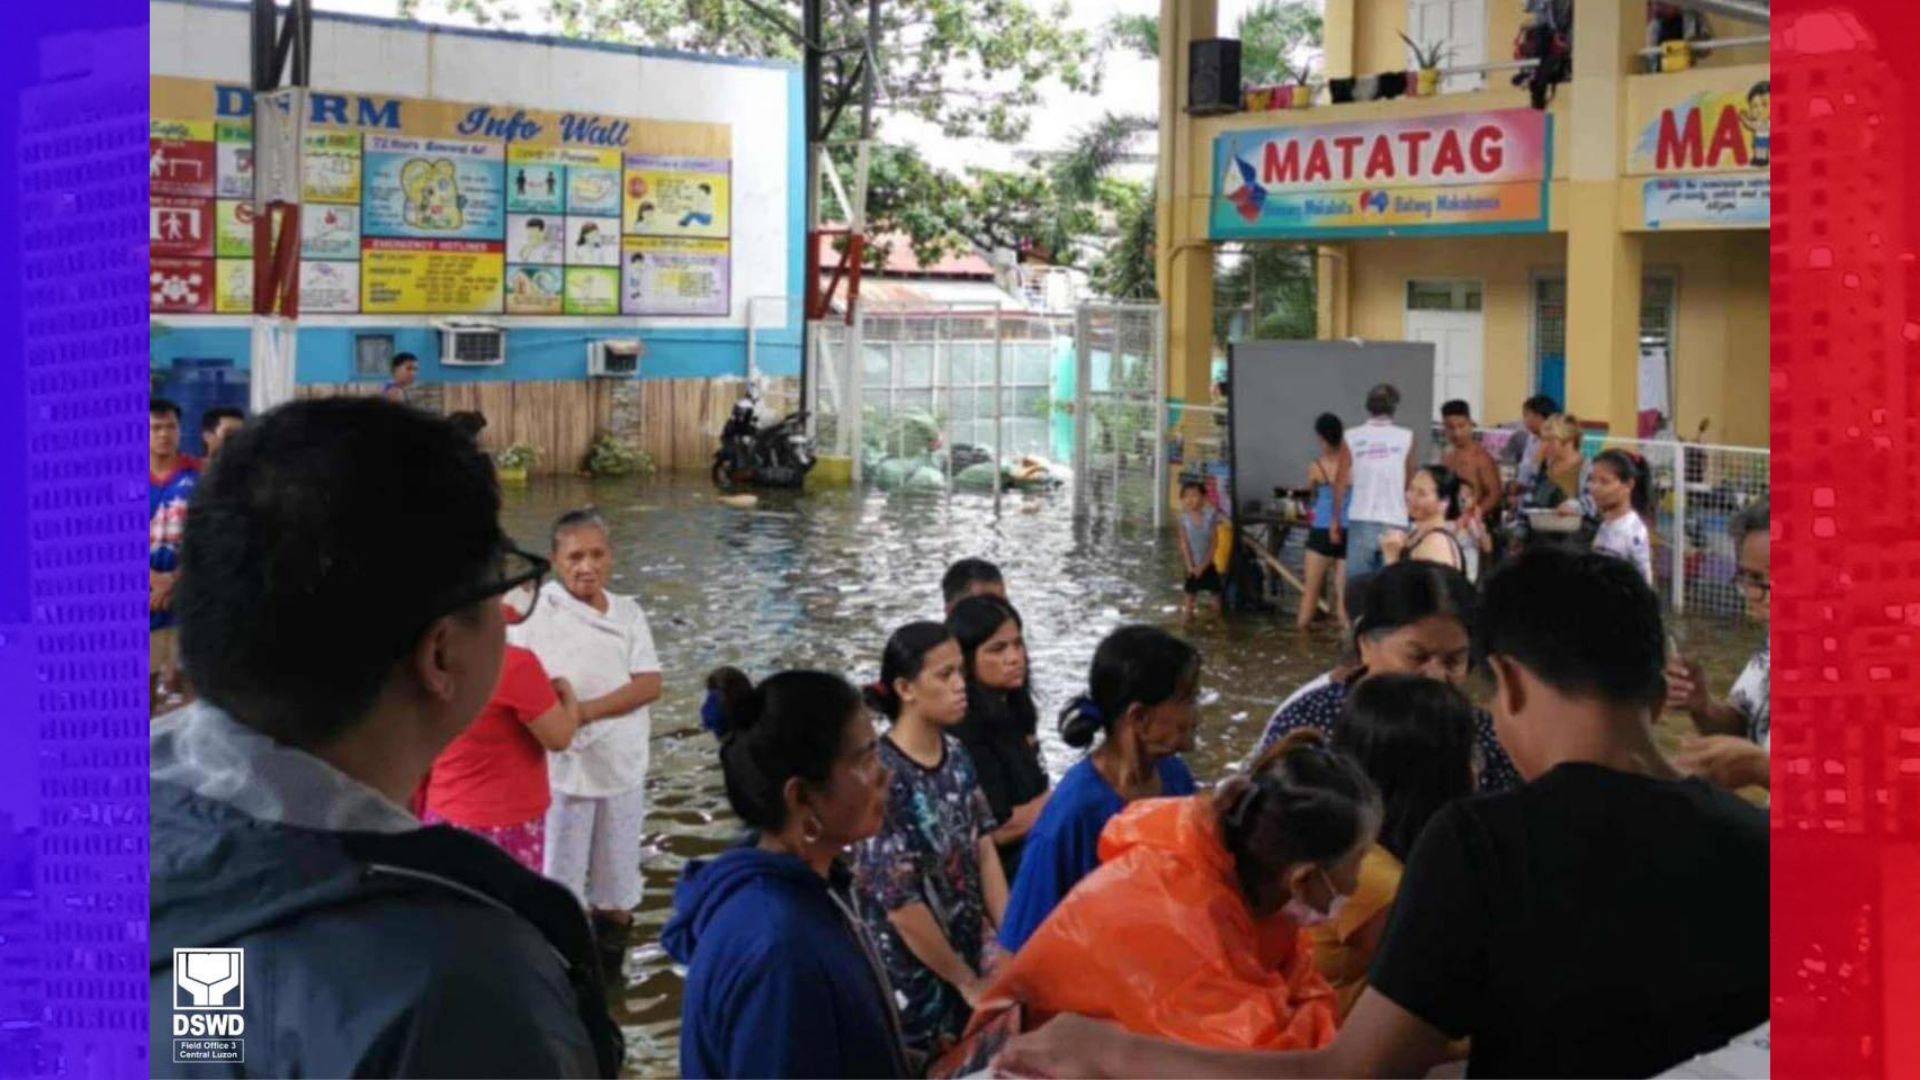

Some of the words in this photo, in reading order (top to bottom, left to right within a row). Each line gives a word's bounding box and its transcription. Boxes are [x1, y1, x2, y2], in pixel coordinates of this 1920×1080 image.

[457, 106, 541, 140] Info
[559, 113, 633, 147] Wall
[1262, 125, 1504, 184] MATATAG
